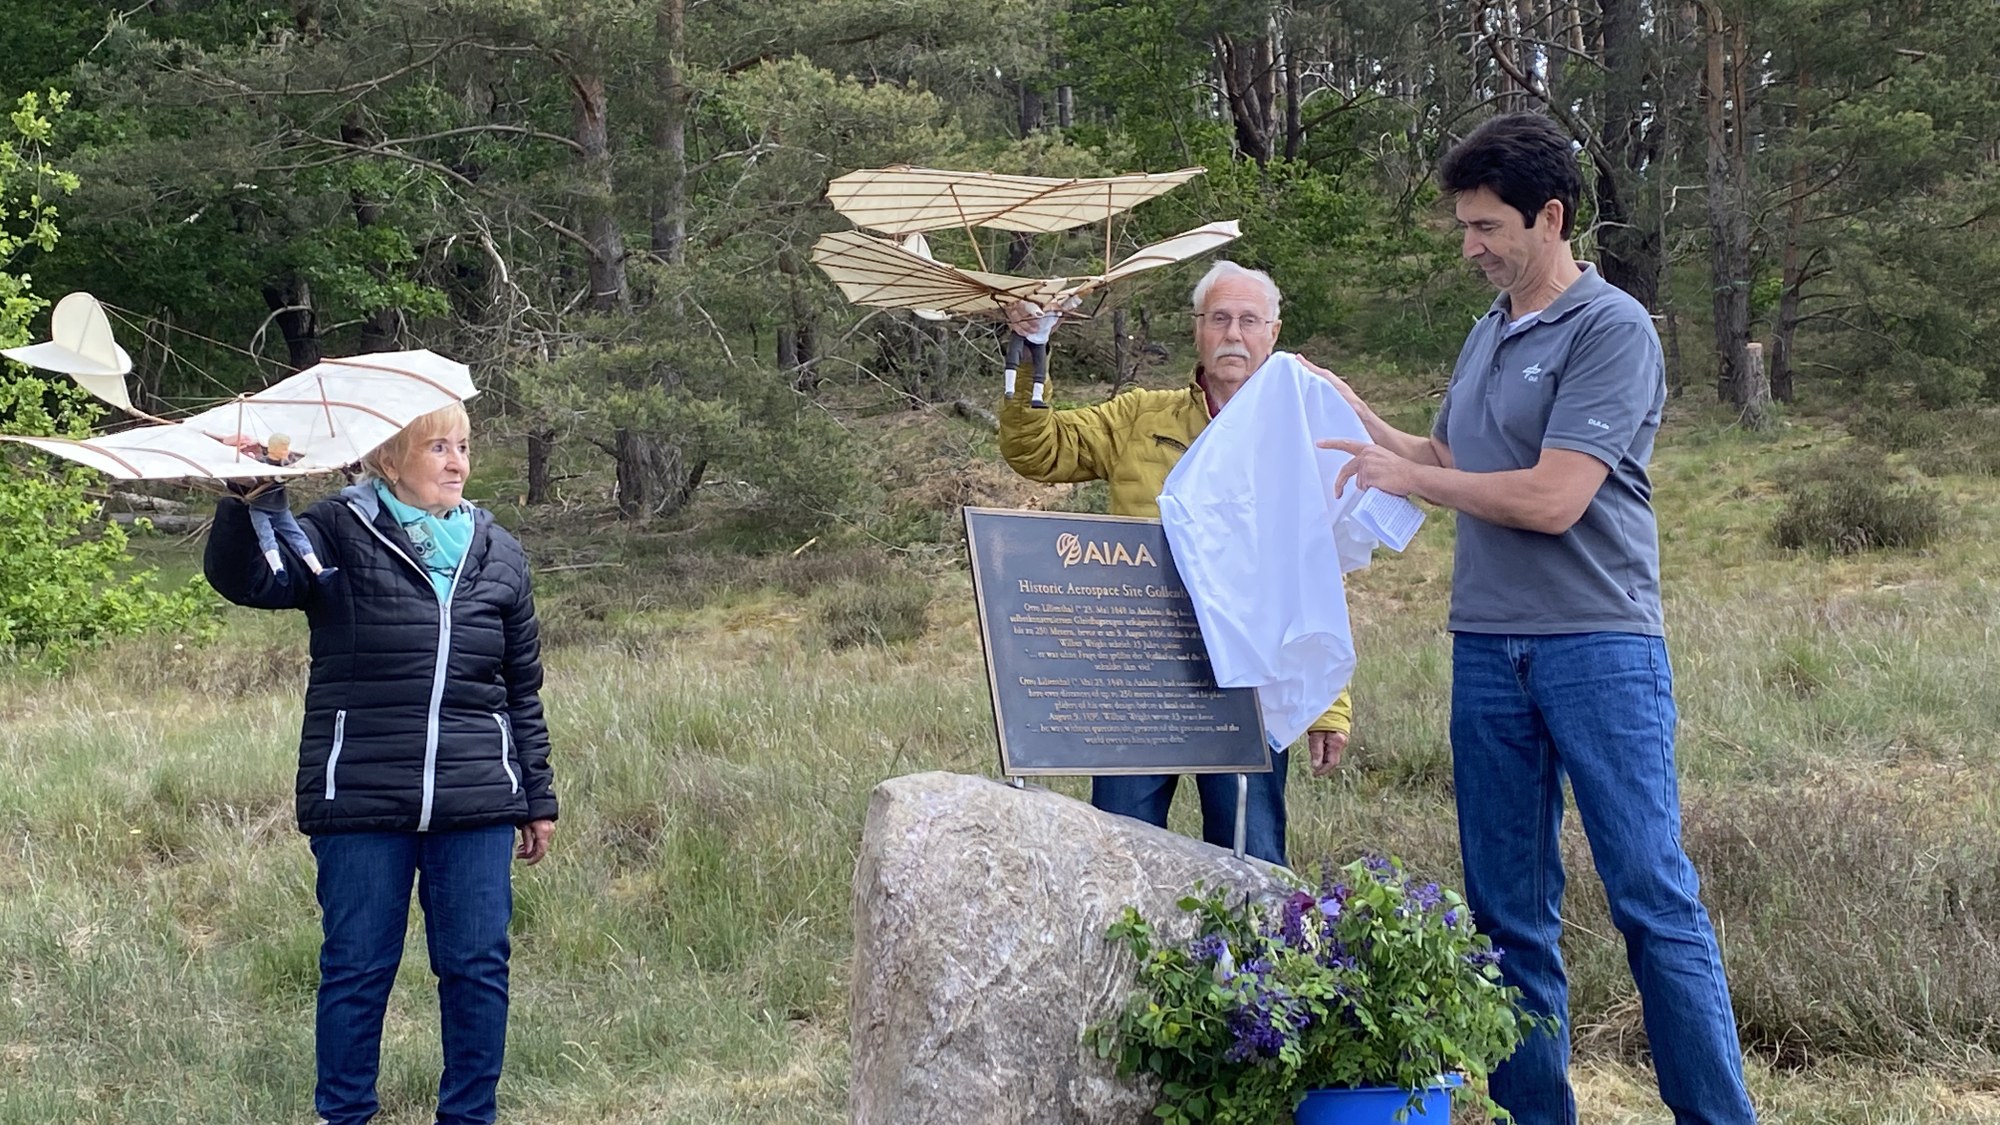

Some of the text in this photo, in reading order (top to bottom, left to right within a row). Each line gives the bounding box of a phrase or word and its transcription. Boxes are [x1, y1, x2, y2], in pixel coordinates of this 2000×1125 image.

[1083, 540, 1157, 567] AIAA
[1018, 579, 1189, 600] Historic Aerospace Site Gollenb
